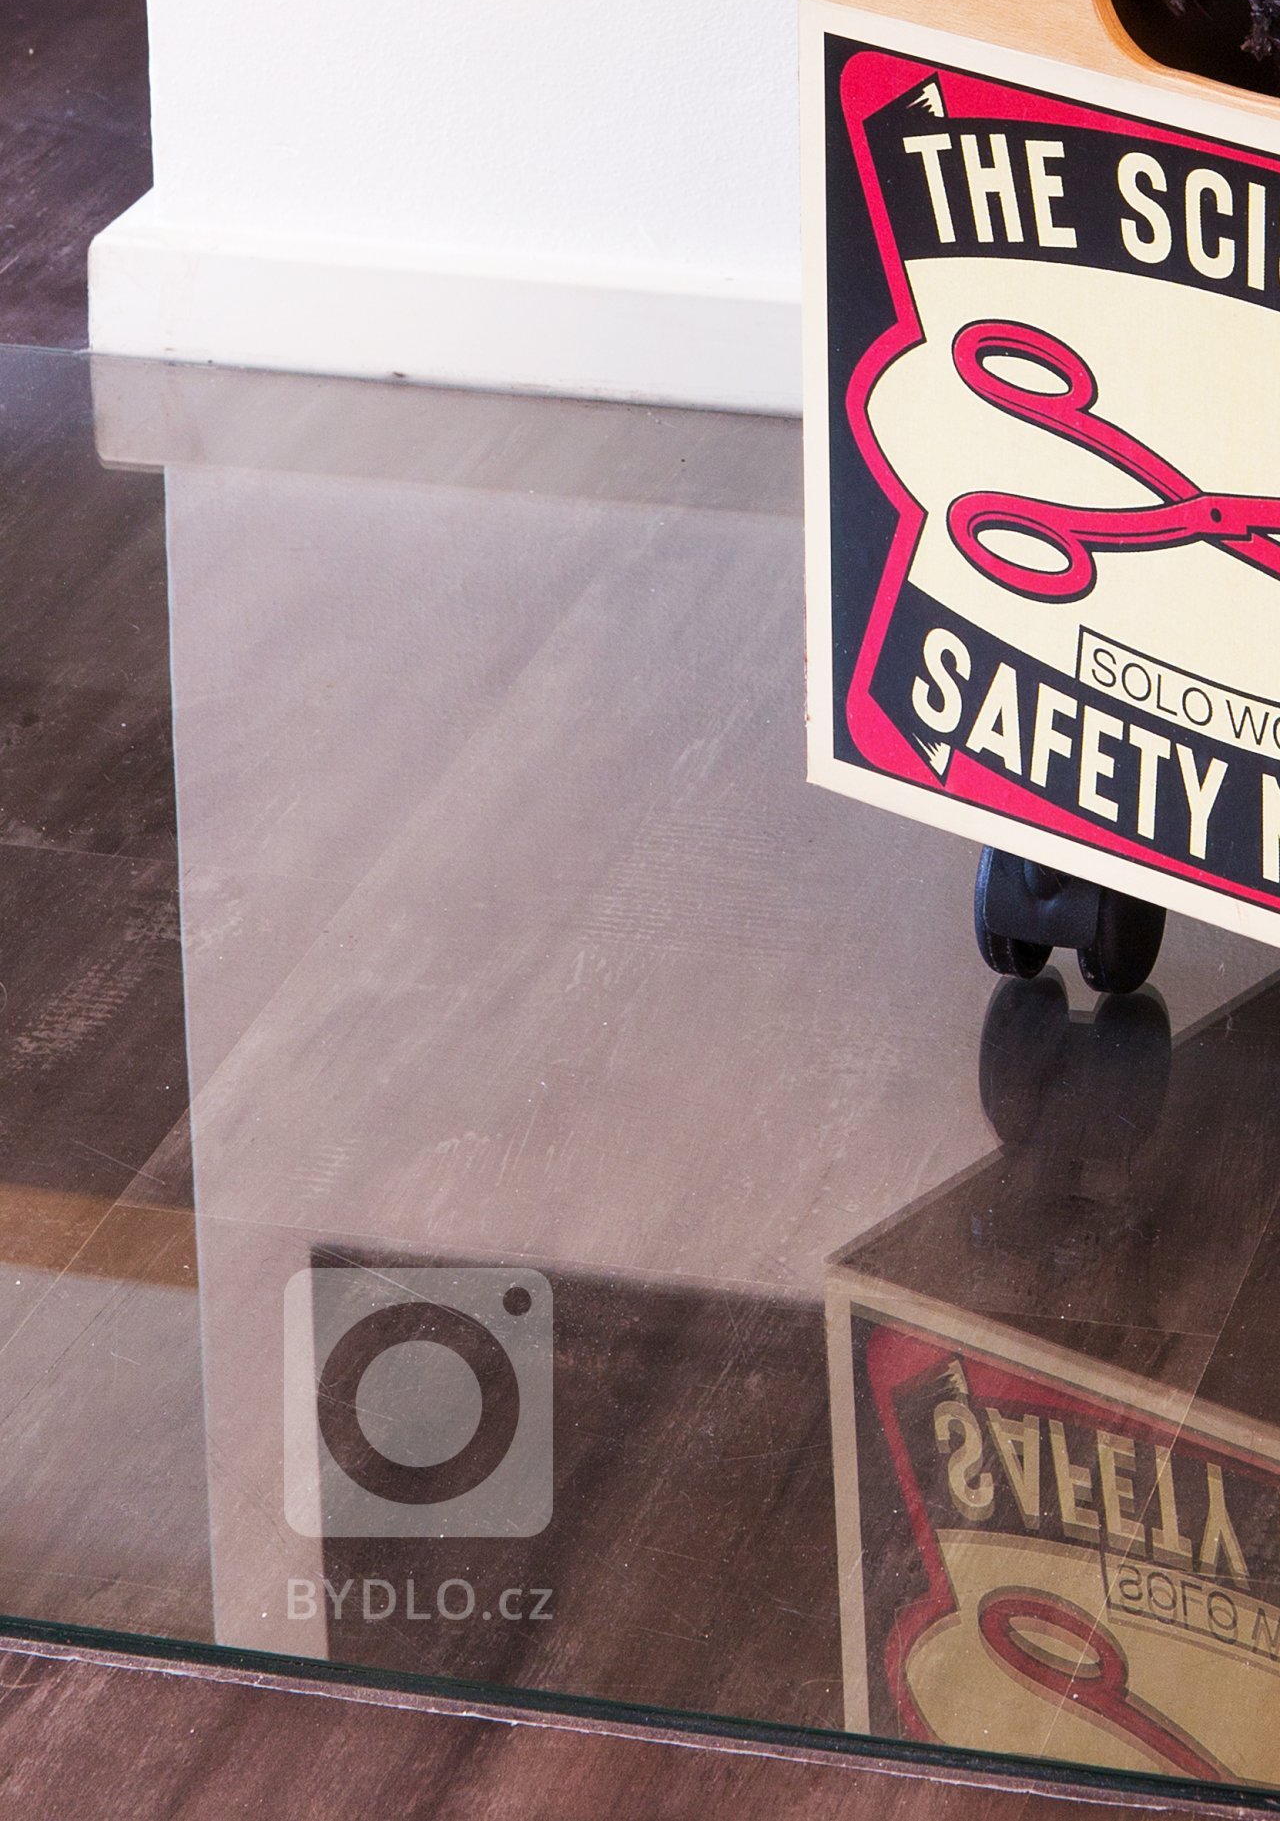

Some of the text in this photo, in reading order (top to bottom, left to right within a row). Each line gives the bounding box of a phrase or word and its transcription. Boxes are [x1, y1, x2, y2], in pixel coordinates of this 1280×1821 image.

[903, 133, 1078, 248] THE
[913, 627, 1228, 858] SAFETY
[1092, 646, 1214, 729] SOLO
